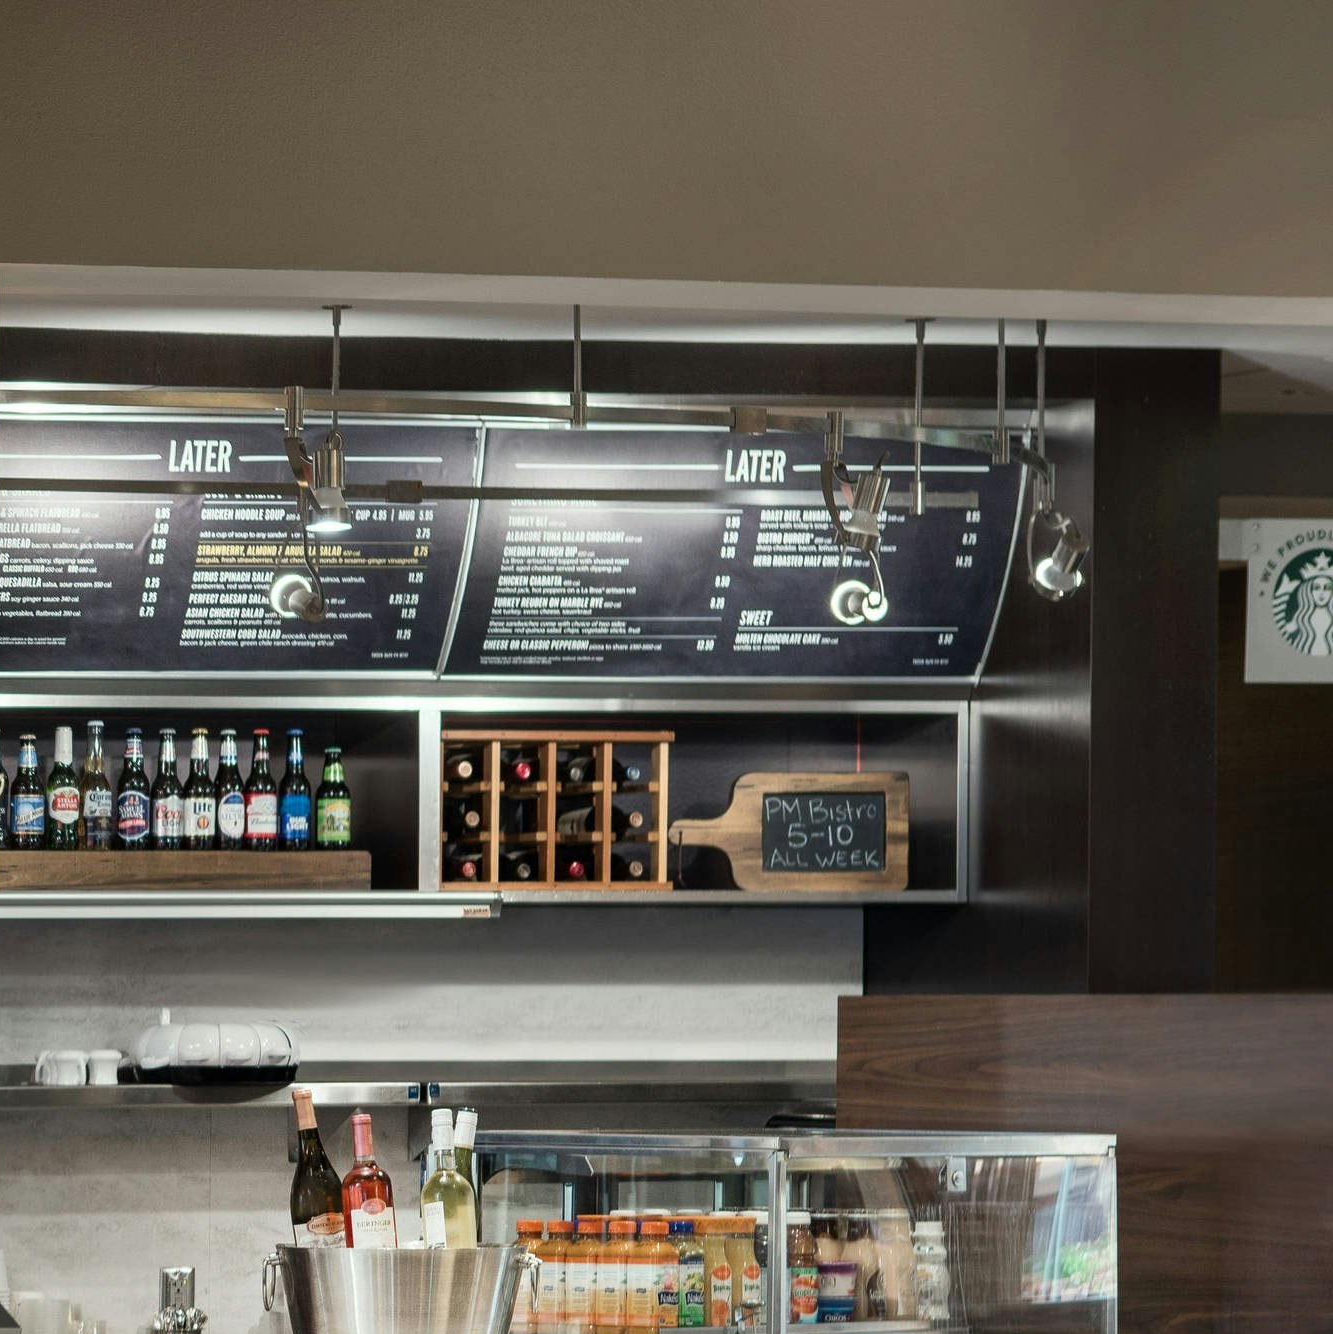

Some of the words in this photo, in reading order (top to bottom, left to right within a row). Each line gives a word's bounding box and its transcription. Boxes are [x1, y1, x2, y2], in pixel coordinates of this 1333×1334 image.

[168, 440, 232, 472] LATER
[725, 449, 786, 483] LATER
[201, 509, 233, 521] CHICKEN
[209, 608, 240, 618] CHICKEN
[242, 608, 265, 619] SALAD
[739, 610, 773, 626] SWEET
[258, 630, 281, 640] SALAD
[483, 640, 509, 650] CHEESE
[521, 640, 550, 650] CLASSIC
[551, 640, 589, 650] PEPPERONI
[765, 797, 801, 824] PM
[809, 798, 877, 824] Bistro
[788, 823, 853, 848] 5-10
[771, 848, 808, 868] ALL
[815, 850, 879, 868] WEEK
